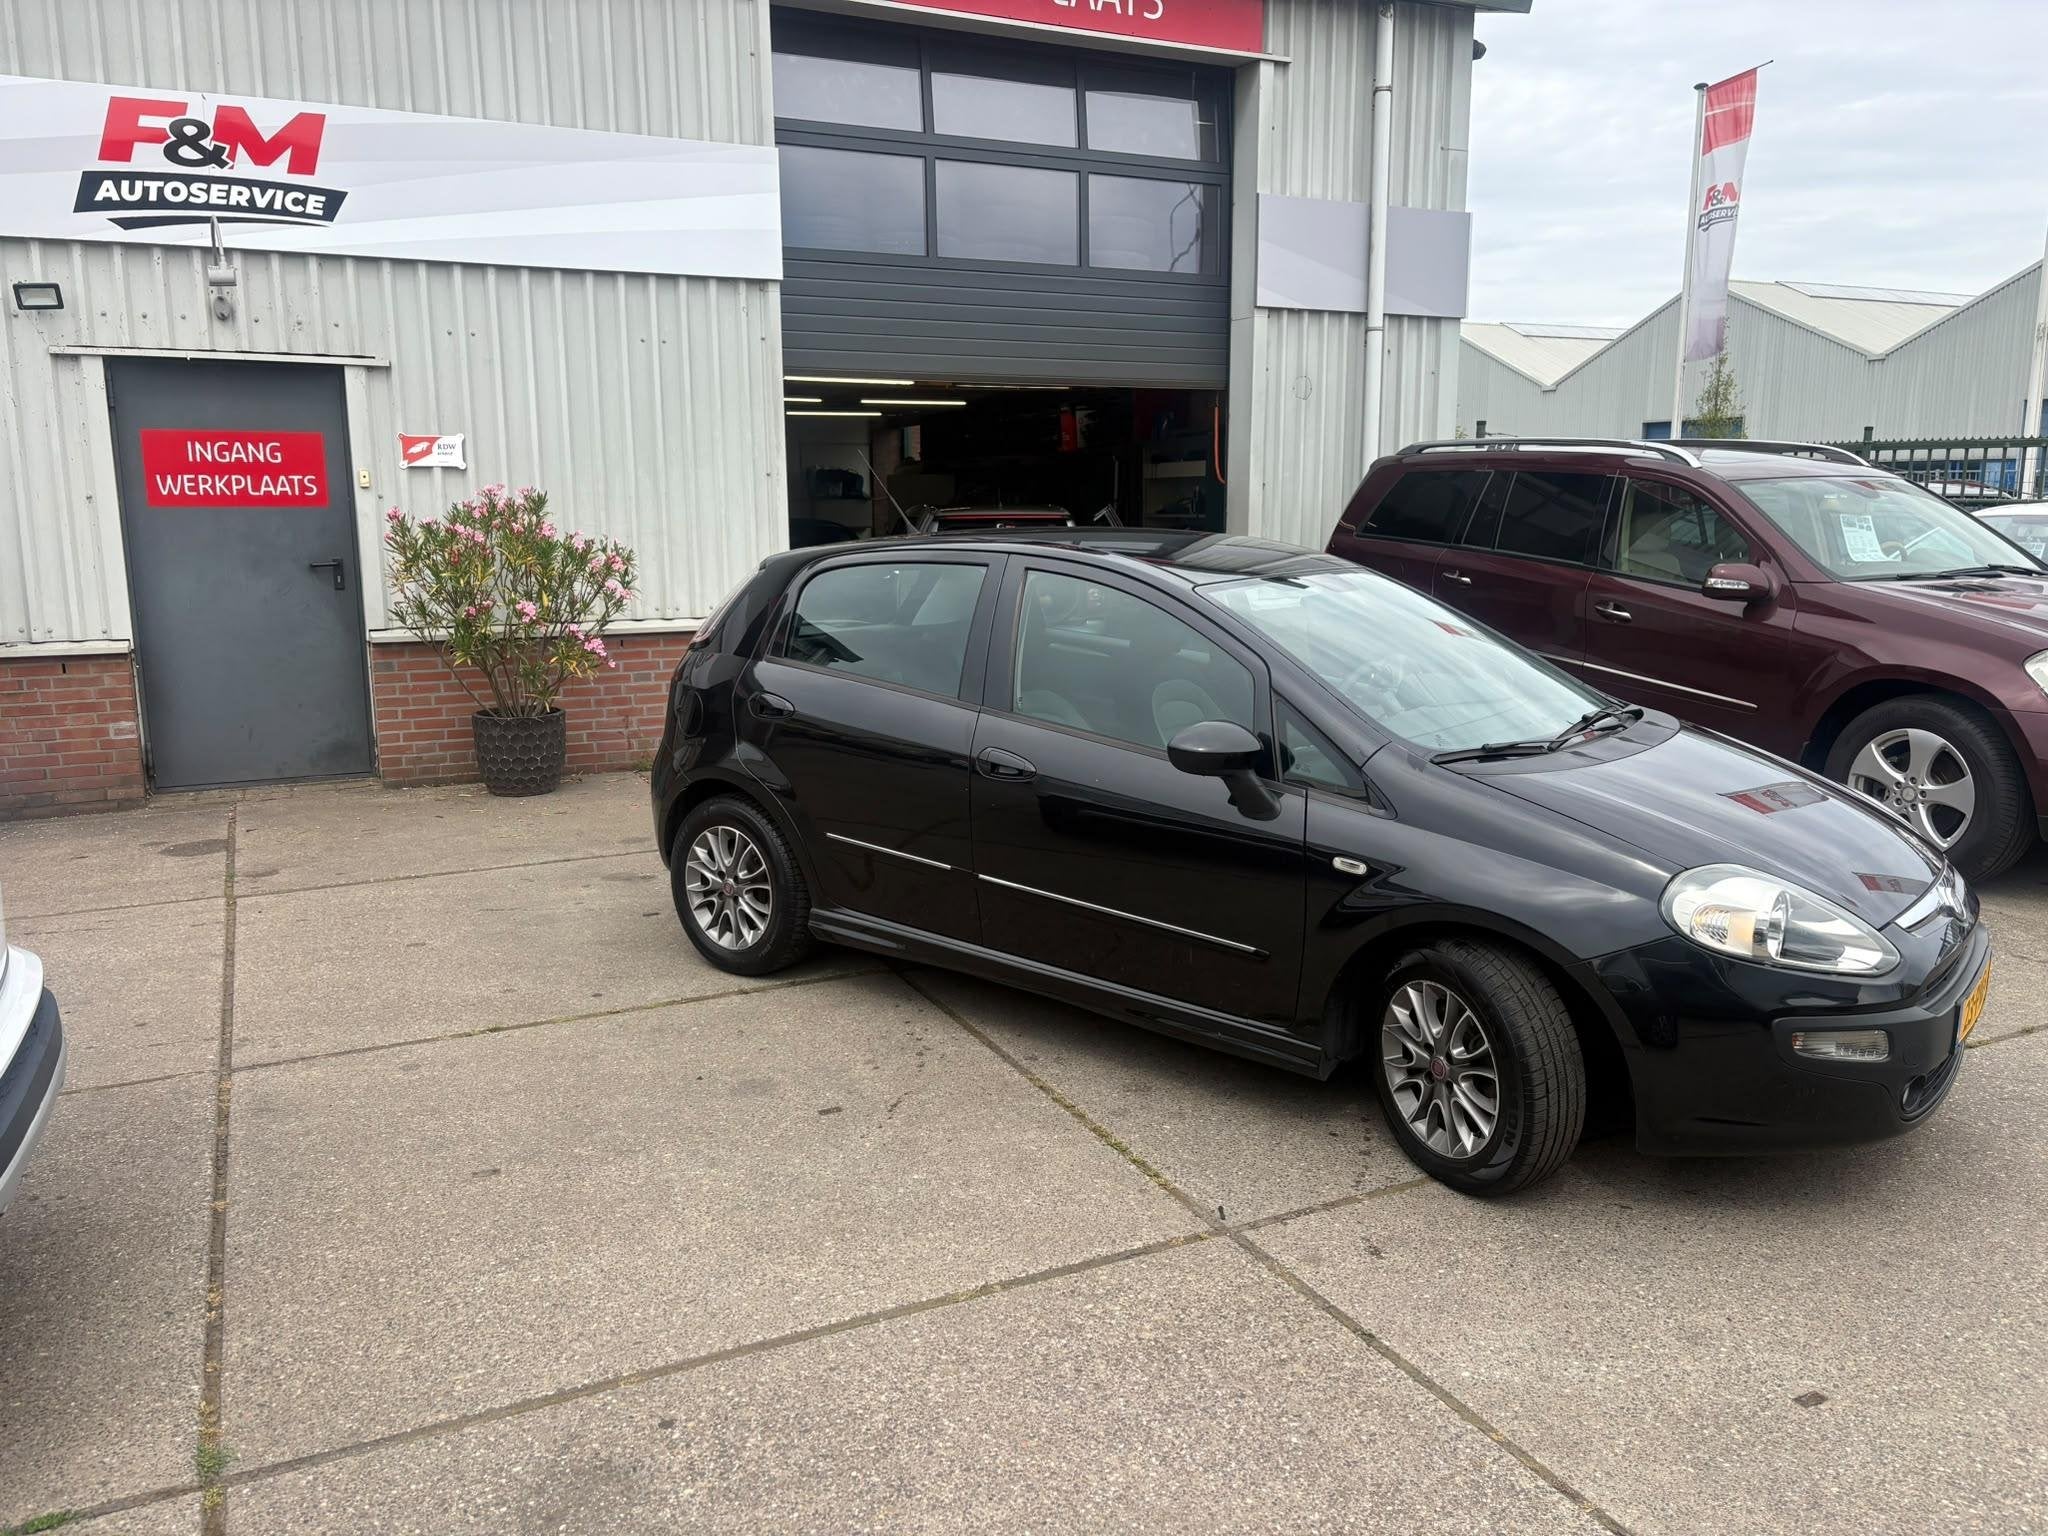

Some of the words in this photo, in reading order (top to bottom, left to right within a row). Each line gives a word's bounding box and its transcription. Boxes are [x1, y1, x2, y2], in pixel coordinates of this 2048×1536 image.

[97, 95, 327, 176] F&M
[94, 179, 326, 217] AUTOSERVICE
[186, 440, 282, 464] INGANG
[437, 442, 457, 450] RDW
[155, 473, 318, 497] WERKPLAATS
